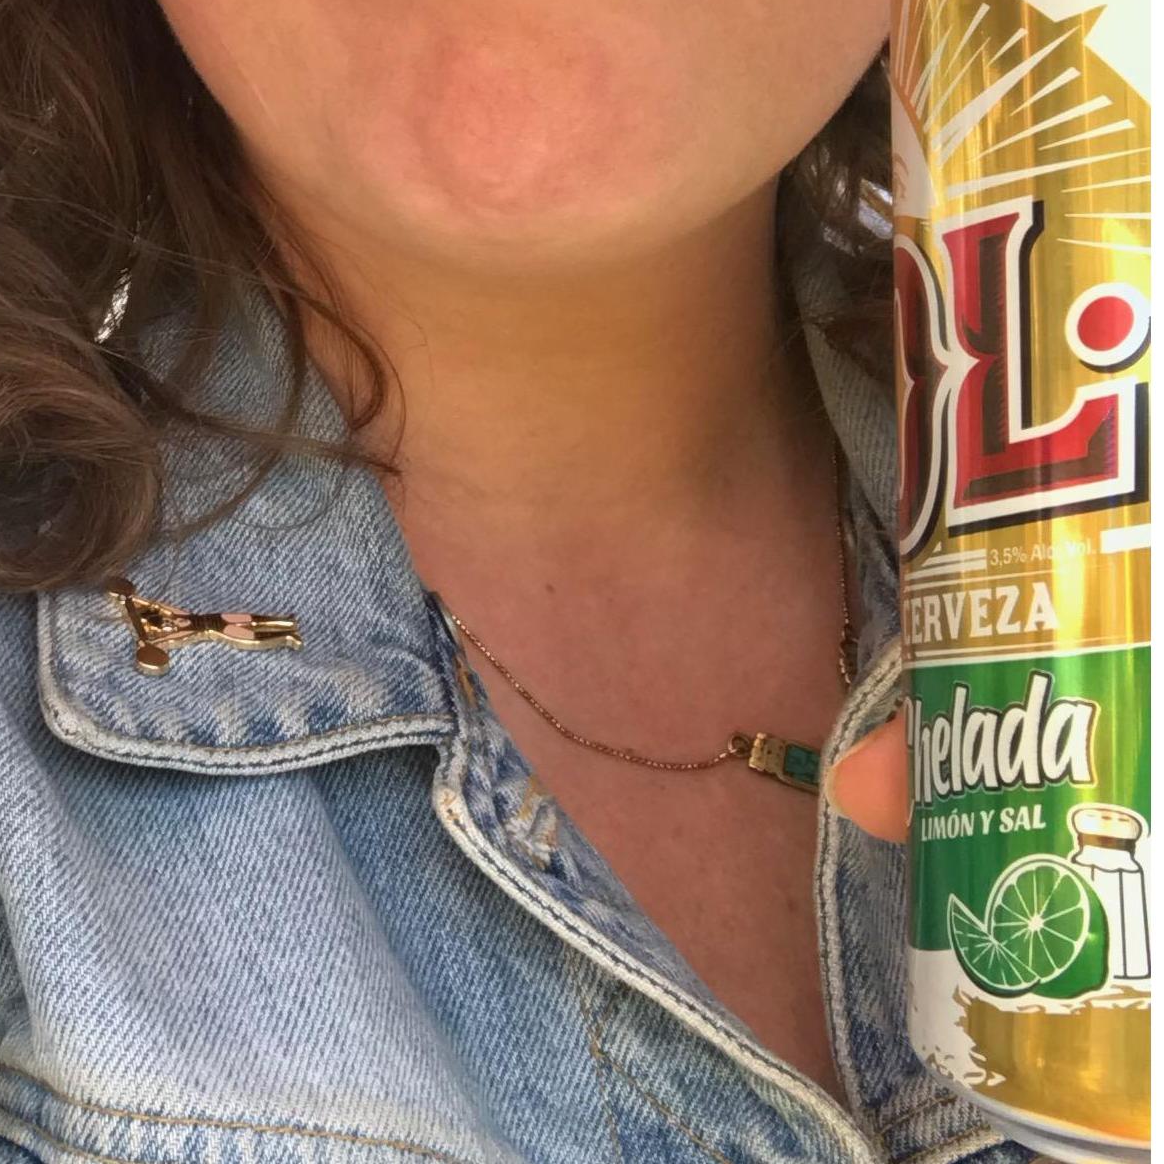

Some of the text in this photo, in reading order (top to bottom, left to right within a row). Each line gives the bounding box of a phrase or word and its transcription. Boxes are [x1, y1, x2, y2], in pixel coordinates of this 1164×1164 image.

[989, 546, 1028, 566] 3,5%
[921, 803, 1047, 841] LIMÓN Y SAL
